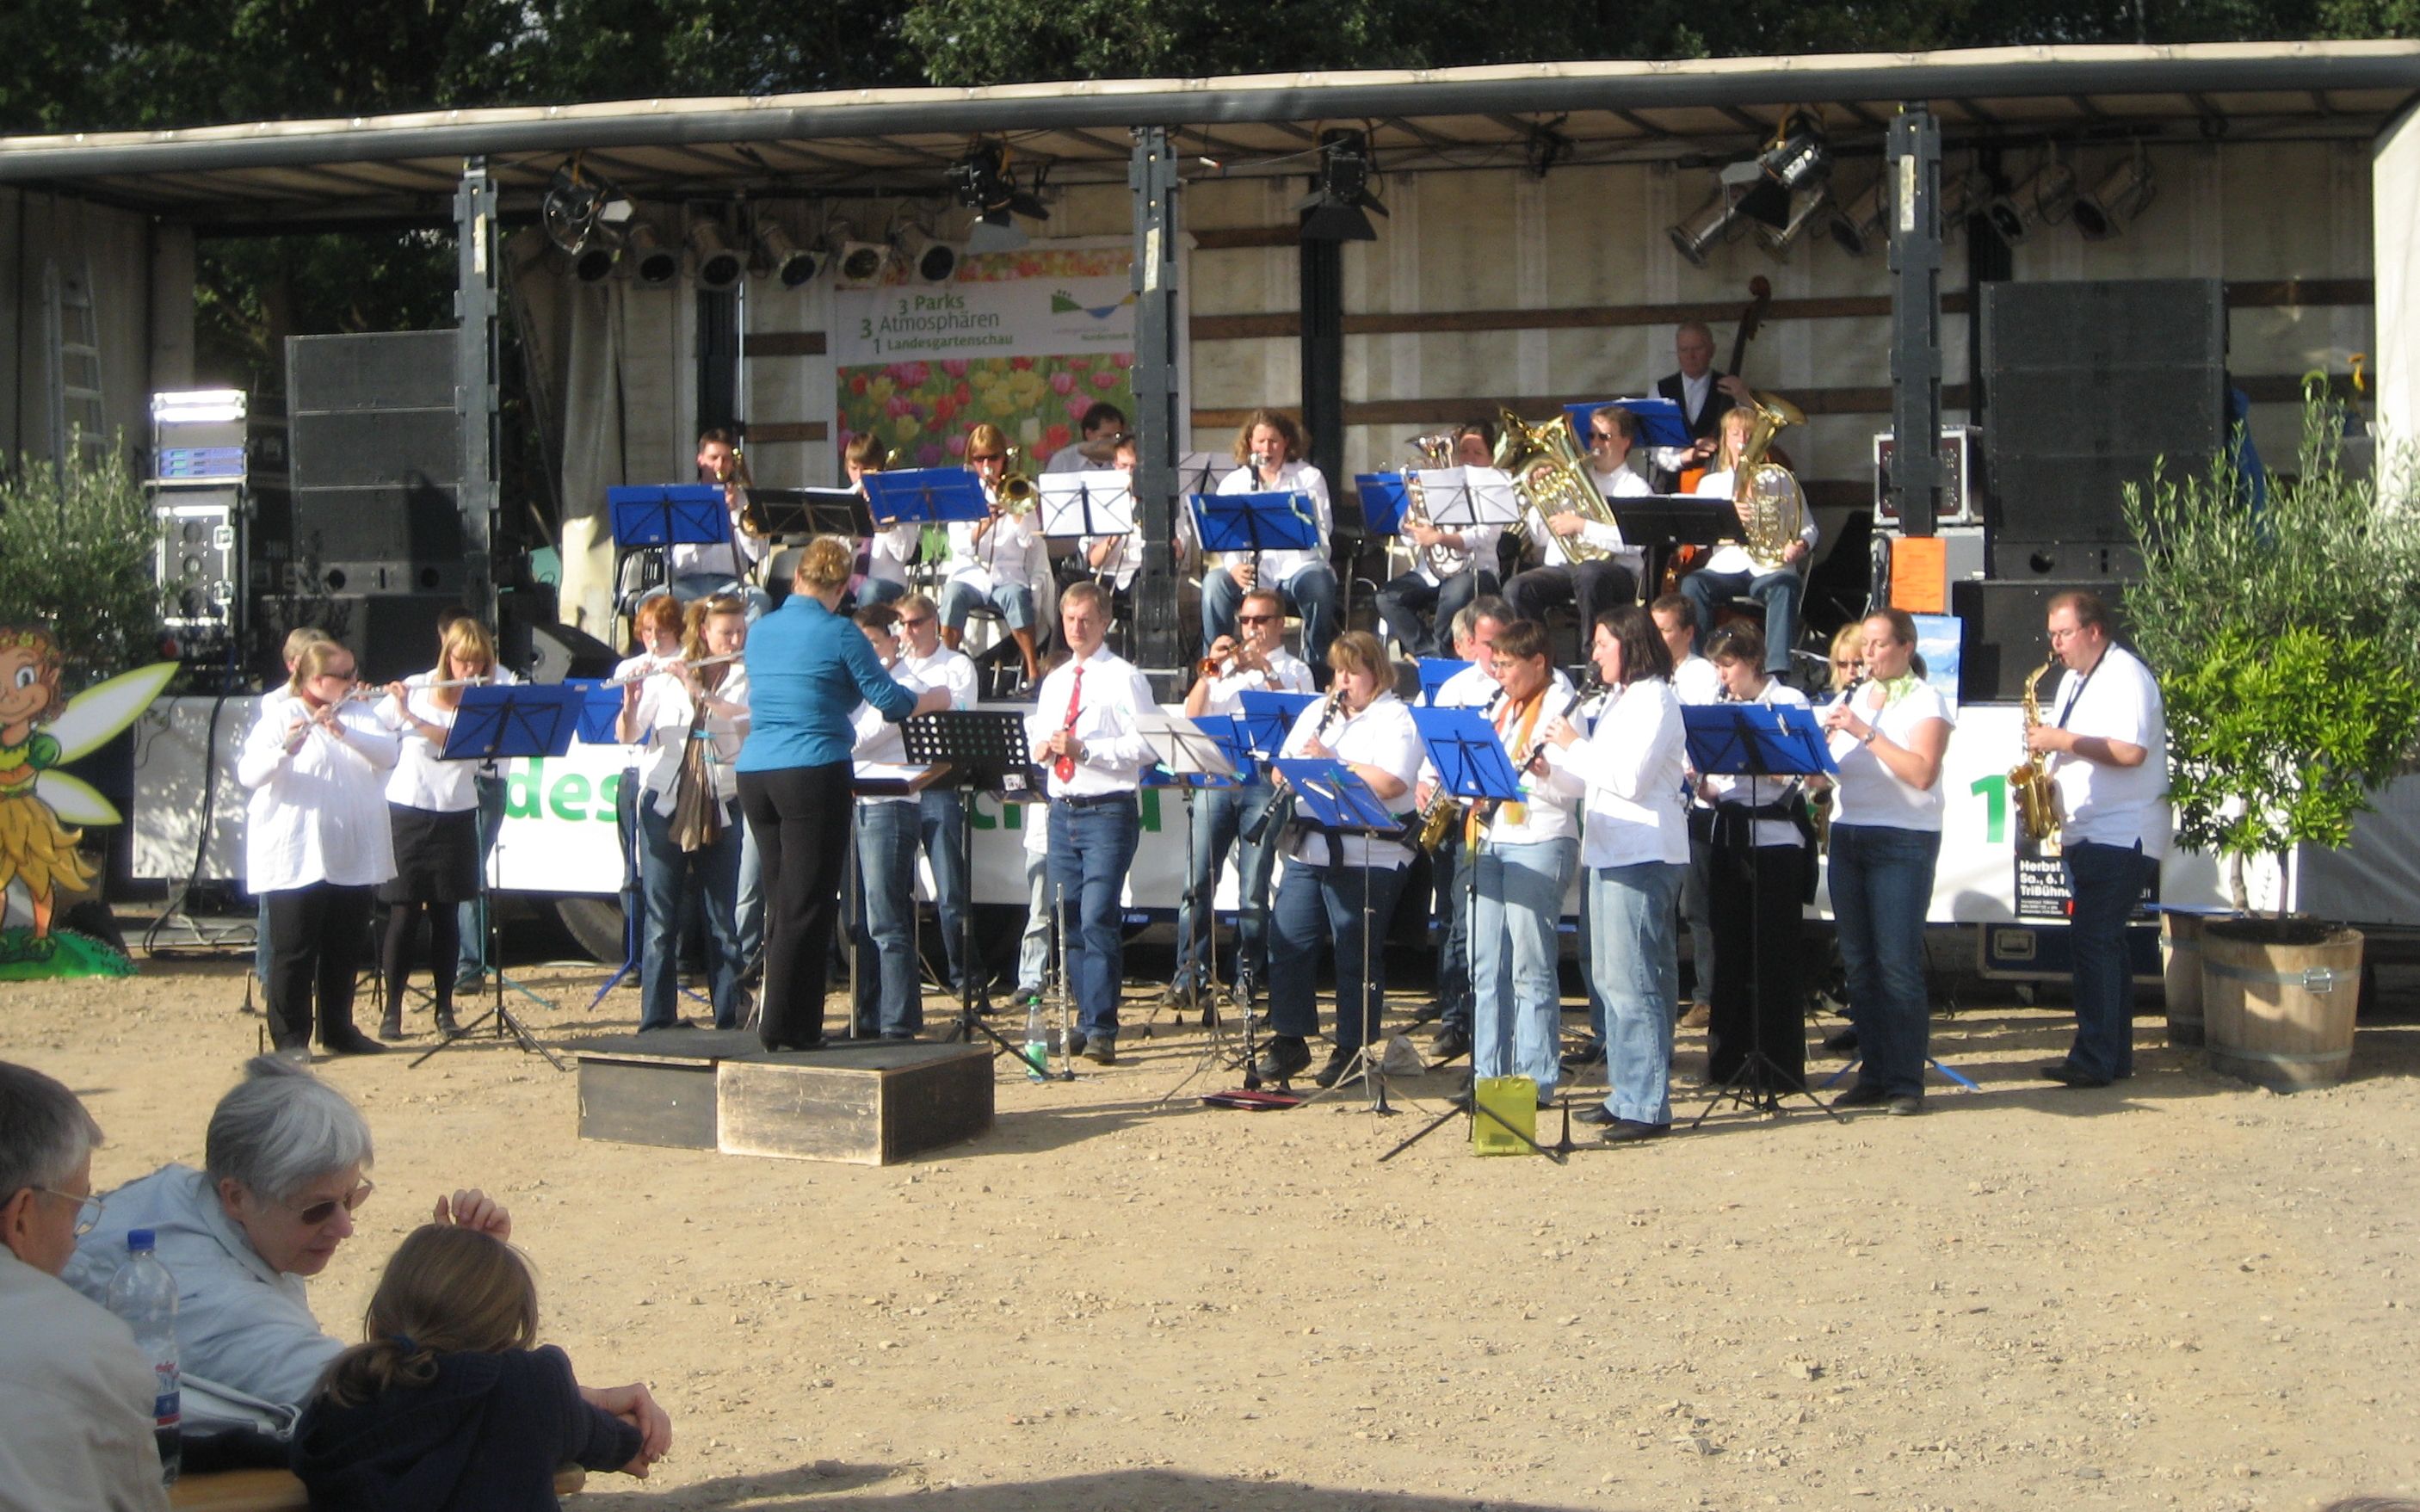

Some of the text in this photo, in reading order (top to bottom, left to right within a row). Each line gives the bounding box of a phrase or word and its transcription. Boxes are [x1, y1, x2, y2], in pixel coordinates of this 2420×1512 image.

[898, 293, 965, 315] 3 Parks
[861, 311, 1000, 339] 3 Atmosphären
[873, 333, 1014, 355] 1 Landesgartenschau
[2020, 860, 2063, 873] Herbst
[2020, 873, 2044, 886] Sa.,
[2046, 873, 2058, 885] 6.
